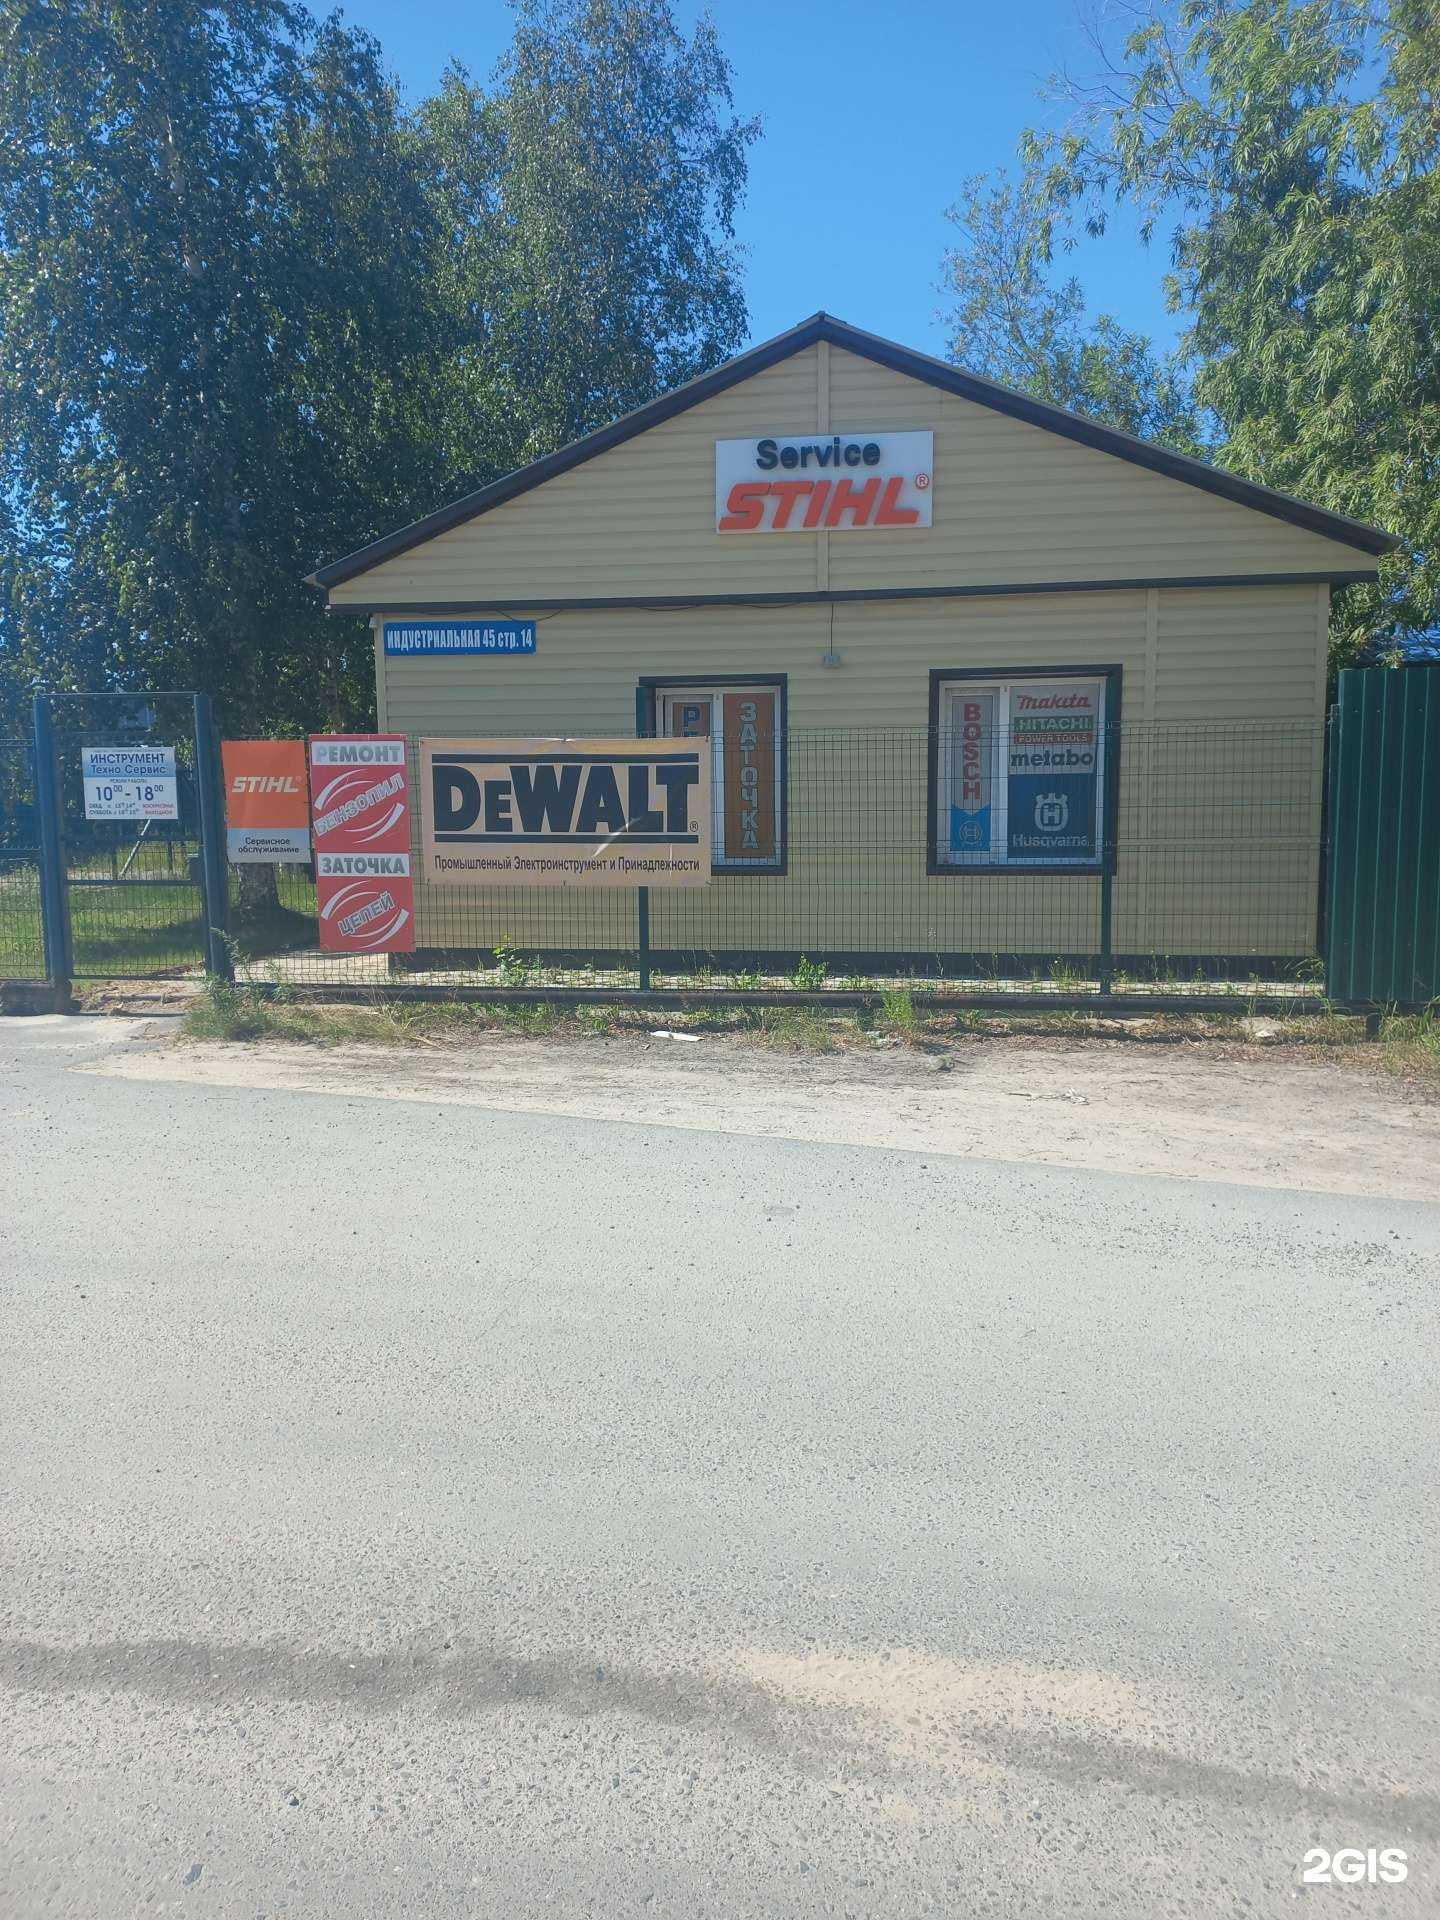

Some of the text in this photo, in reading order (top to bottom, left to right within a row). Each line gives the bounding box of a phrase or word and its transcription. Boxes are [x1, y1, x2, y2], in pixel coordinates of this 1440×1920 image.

[756, 437, 880, 470] Service
[719, 477, 919, 530] STIHL
[387, 629, 532, 650] ИНДУСТРИАЛЬНАЯ 45 стр. 14
[1019, 716, 1090, 731] HITACHI
[1019, 733, 1089, 743] POWER TOOLS
[90, 753, 165, 764] ИНСТРУМЕНТ
[315, 744, 402, 763] РЕМОНТ
[963, 703, 981, 800] BOSCH
[1011, 749, 1094, 767] metabo
[91, 764, 166, 775] Техно Сервис
[738, 702, 759, 849] ЗАТОЧКА
[232, 777, 299, 793] STIHL
[313, 772, 405, 837] БЕНЗОПИЛ
[245, 837, 290, 846] Сервисное
[1012, 833, 1089, 848] Husqvarna
[238, 846, 300, 855] обслуживание
[322, 856, 405, 875] ЗАТОЧКА
[434, 855, 700, 874] Промышленный Электроинструмент и Принадлежности
[337, 890, 396, 937] ЦЕПЕЙ
